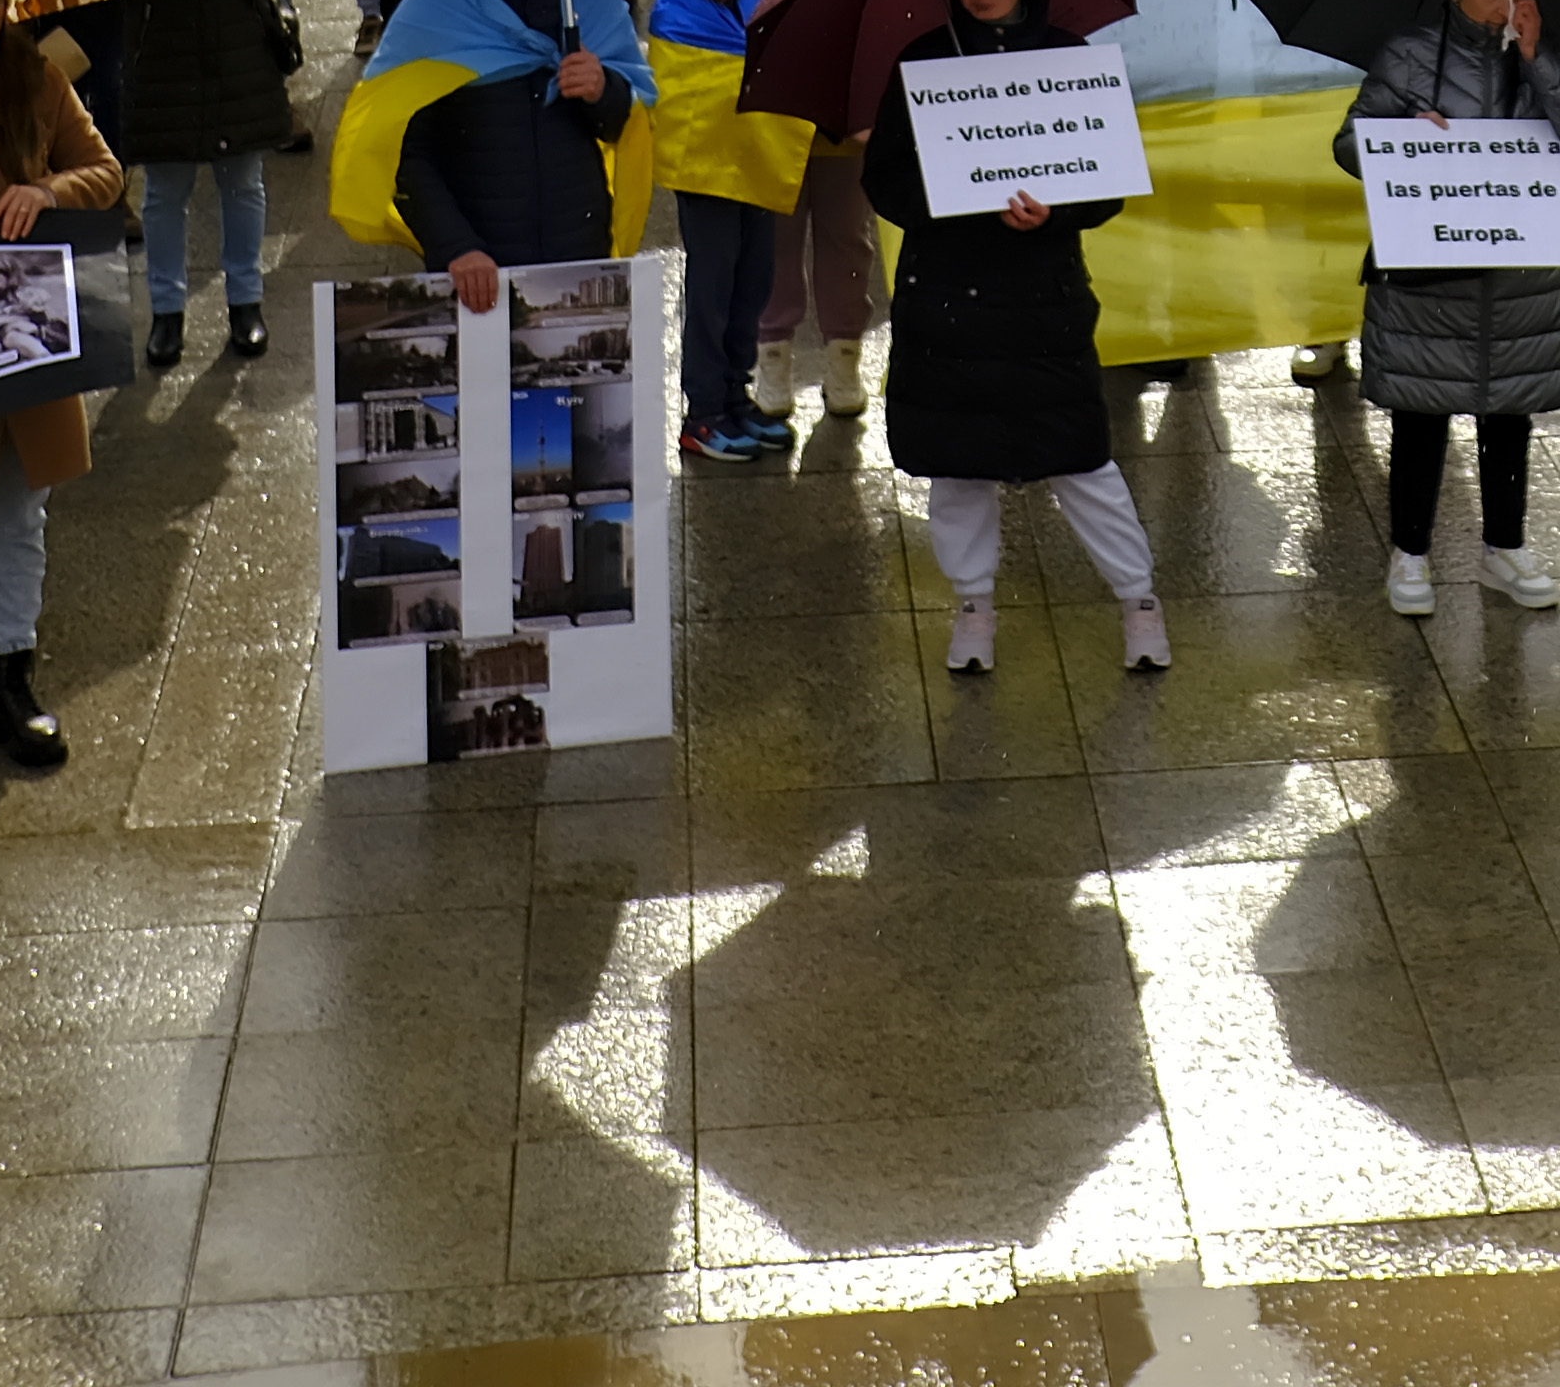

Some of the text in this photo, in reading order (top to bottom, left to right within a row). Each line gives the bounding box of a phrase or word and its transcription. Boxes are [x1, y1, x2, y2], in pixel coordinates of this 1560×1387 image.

[910, 72, 1121, 107] Victoria de Ucrania
[958, 119, 1047, 143] Victoria
[1052, 117, 1079, 134] de
[1084, 115, 1105, 131] la
[1365, 137, 1395, 155] La
[1402, 140, 1482, 159] guerra
[1489, 136, 1541, 155] está
[969, 156, 1099, 184] democracia
[1385, 180, 1558, 201] las puertas de
[1433, 224, 1526, 245] Europa.
